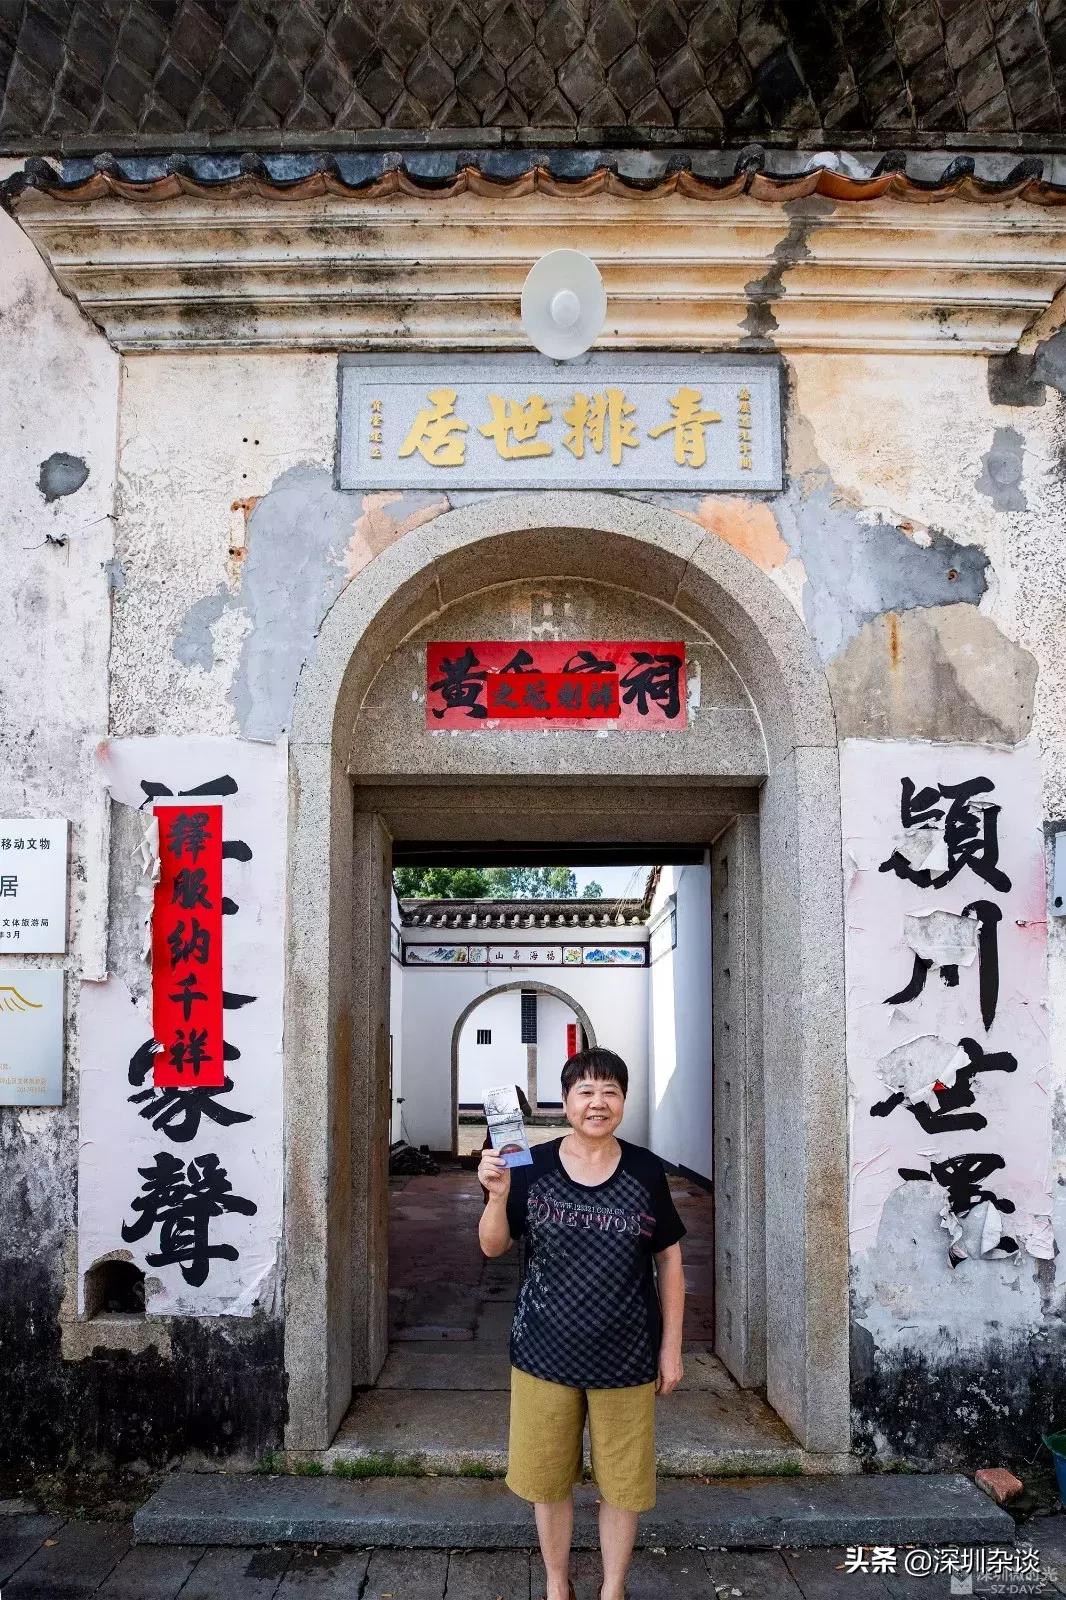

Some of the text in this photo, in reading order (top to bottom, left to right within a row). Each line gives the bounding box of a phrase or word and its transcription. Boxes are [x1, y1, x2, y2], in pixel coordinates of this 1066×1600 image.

[397, 387, 723, 467] 青排世居
[1, 838, 51, 850] 移动文物
[0, 875, 18, 897] 居
[2, 918, 49, 927] 文体旅游局
